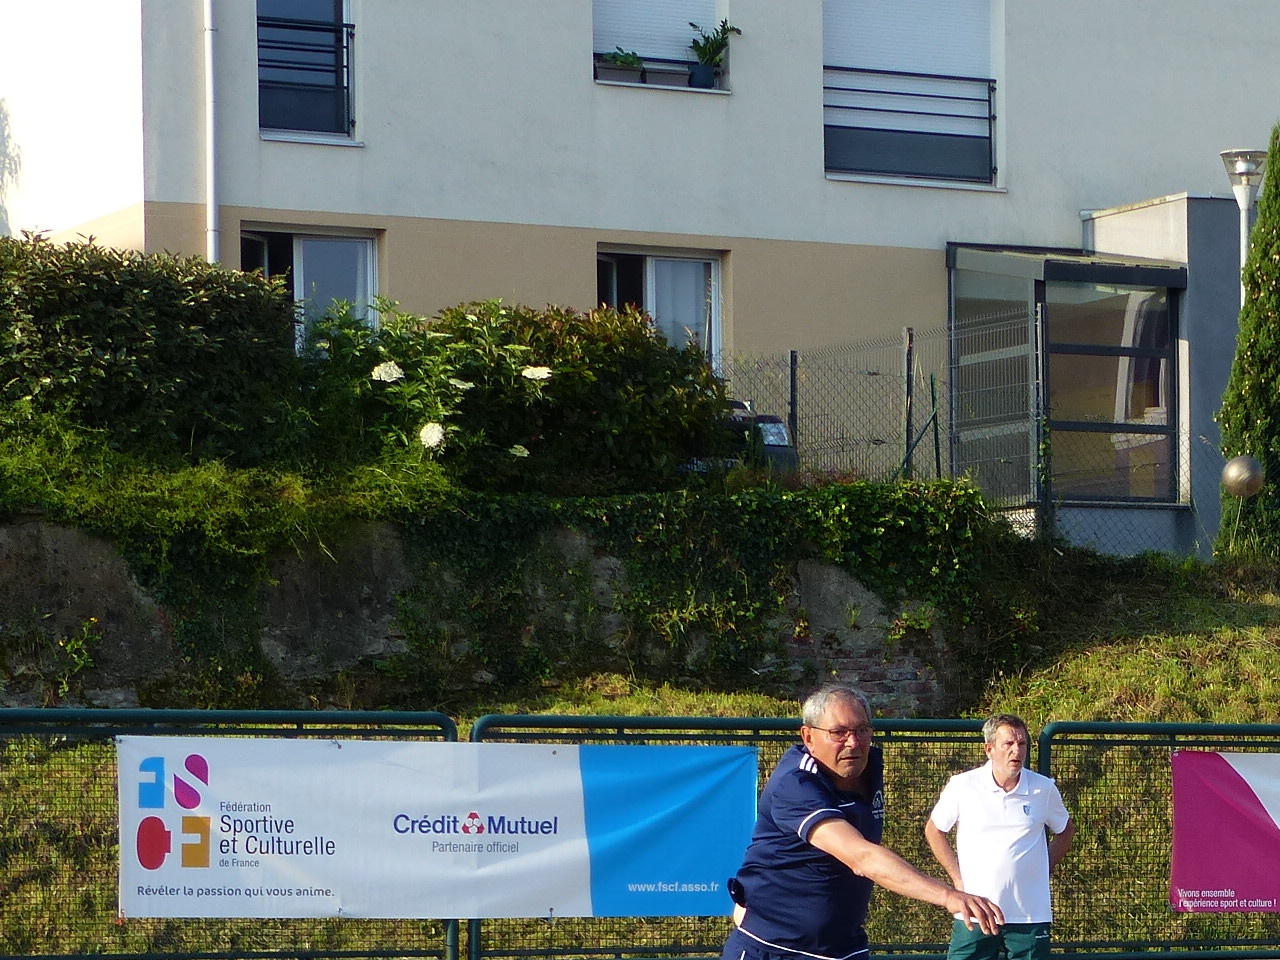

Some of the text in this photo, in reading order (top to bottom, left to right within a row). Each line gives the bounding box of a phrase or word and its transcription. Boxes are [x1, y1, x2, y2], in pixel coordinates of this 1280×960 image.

[219, 801, 271, 812] Fédération
[219, 814, 295, 836] Sportive
[393, 814, 559, 835] Crédit Mutuel
[219, 835, 336, 855] et Culturelle
[432, 841, 519, 853] Partenaire officiel
[218, 858, 260, 868] de France
[136, 884, 335, 898] Révéler la passion qui vous anime.
[628, 881, 719, 892] www.fscf.asso.fr
[1178, 889, 1235, 897] Vivons ensemble
[1220, 899, 1238, 908] sport
[1239, 899, 1247, 907] et
[1248, 899, 1272, 907] culture
